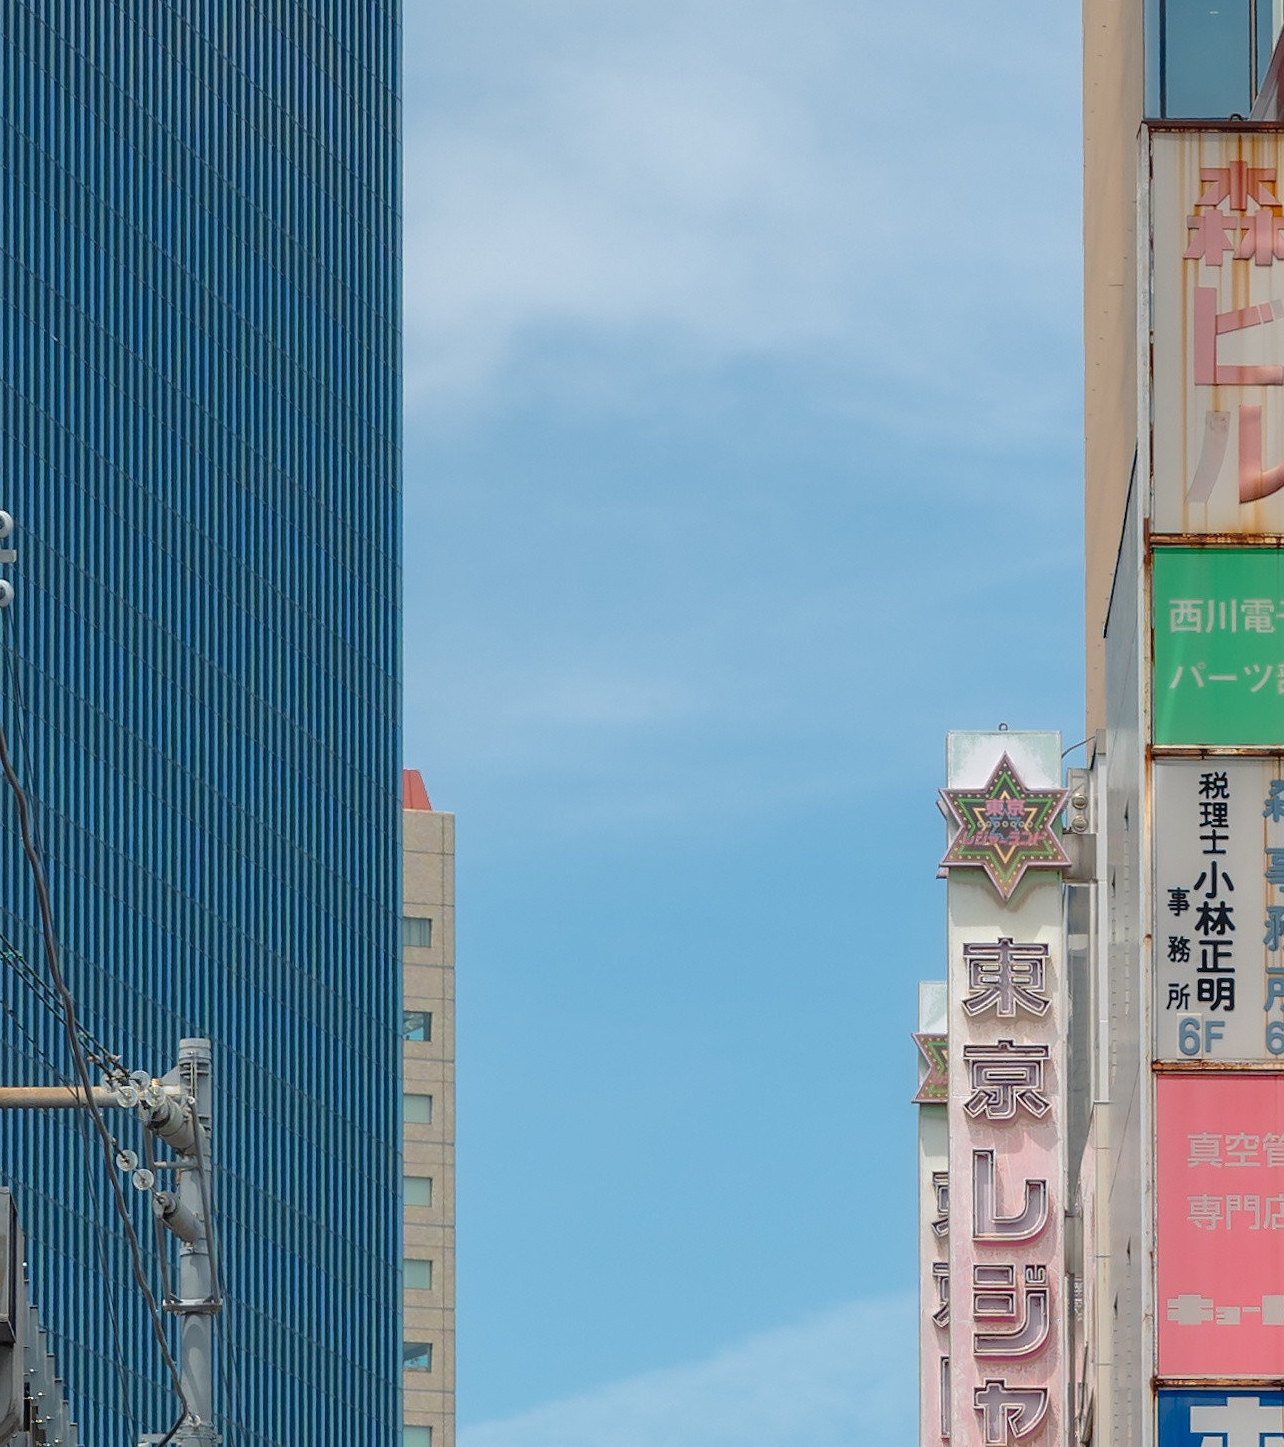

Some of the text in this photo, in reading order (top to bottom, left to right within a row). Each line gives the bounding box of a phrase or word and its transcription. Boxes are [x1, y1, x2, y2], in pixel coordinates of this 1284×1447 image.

[1165, 887, 1192, 1011] 事務所
[1193, 771, 1236, 1012] 税理士小林正明
[1178, 1017, 1227, 1056] 6F
